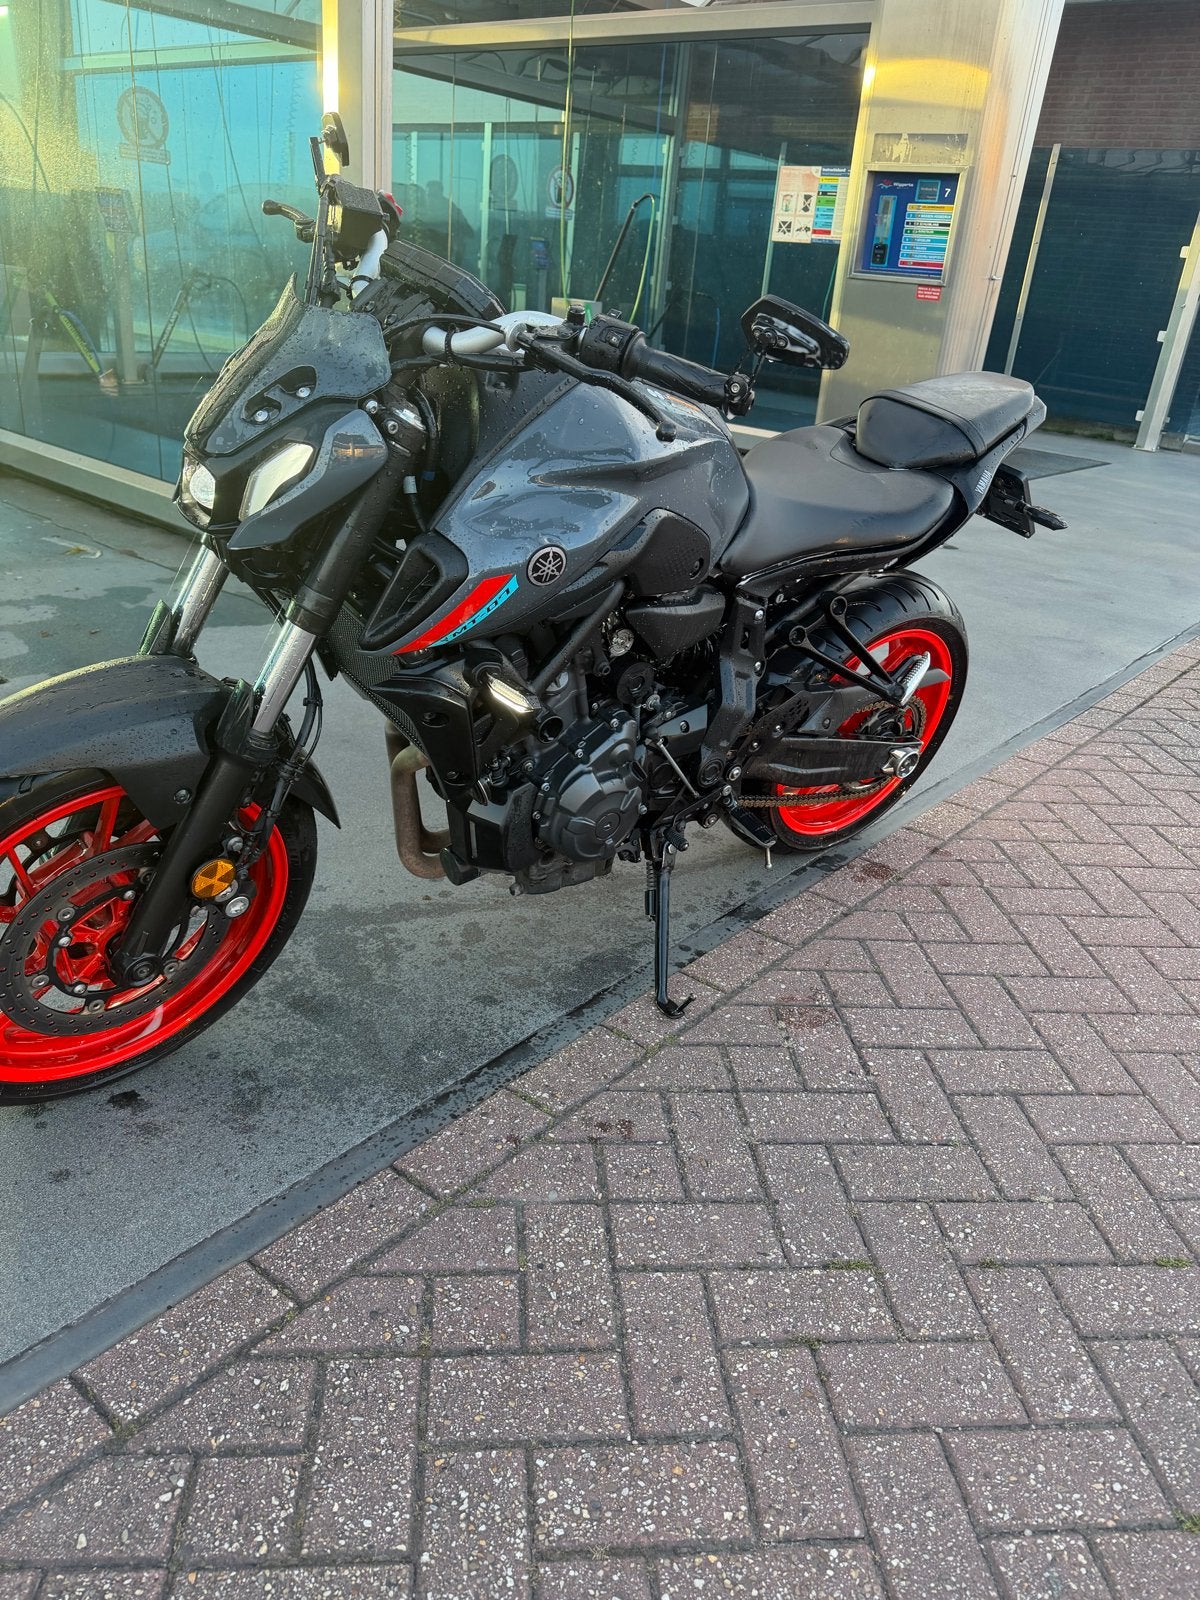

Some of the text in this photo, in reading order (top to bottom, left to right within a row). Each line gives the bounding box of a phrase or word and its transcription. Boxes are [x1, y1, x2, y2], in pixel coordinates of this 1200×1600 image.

[944, 188, 951, 198] 7
[974, 469, 992, 495] YAMAHA
[452, 588, 510, 638] MT-07
